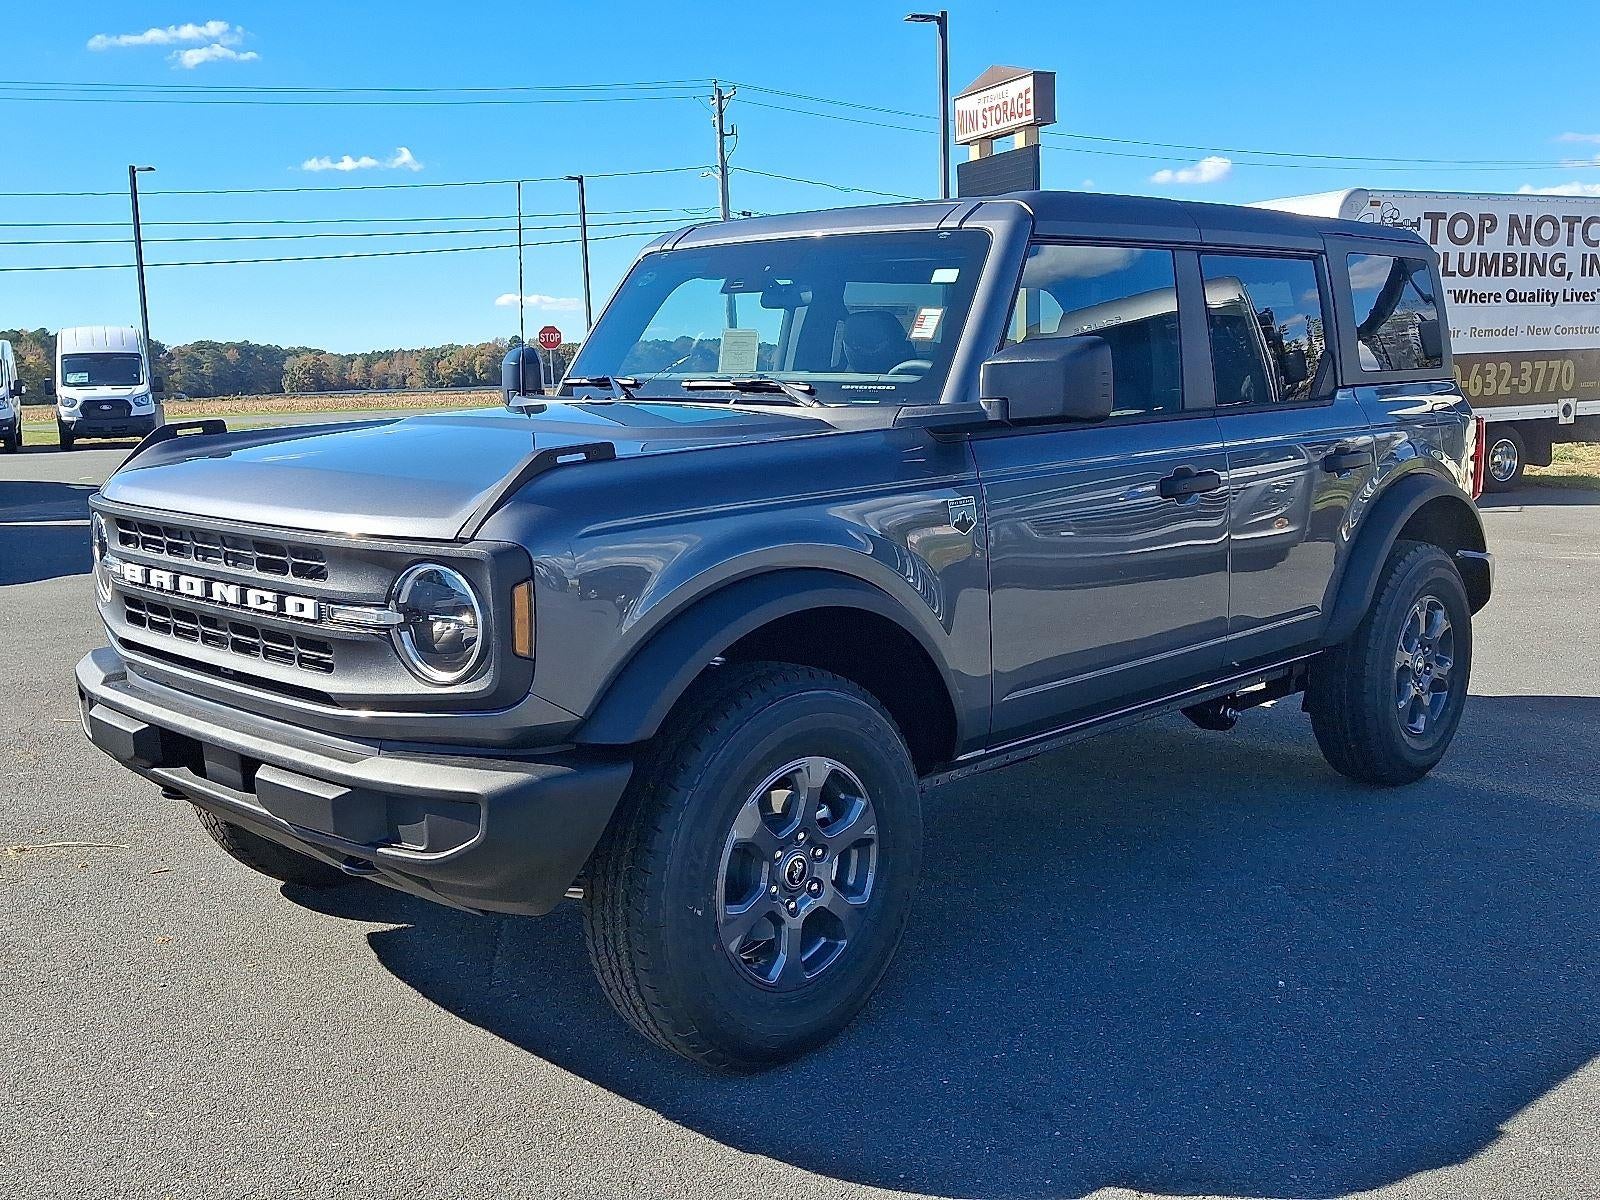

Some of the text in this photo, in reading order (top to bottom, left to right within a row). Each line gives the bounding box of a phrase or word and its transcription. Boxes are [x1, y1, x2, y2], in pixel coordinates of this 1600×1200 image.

[957, 87, 1032, 137] MINI STORAGE
[1423, 212, 1600, 248] TOP NOTC
[1447, 289, 1502, 304] "Where
[1505, 288, 1560, 307] Quality
[540, 333, 560, 343] STOP
[1469, 326, 1519, 338] Remodel
[1526, 325, 1551, 336] New
[122, 561, 320, 620] BRONCO
